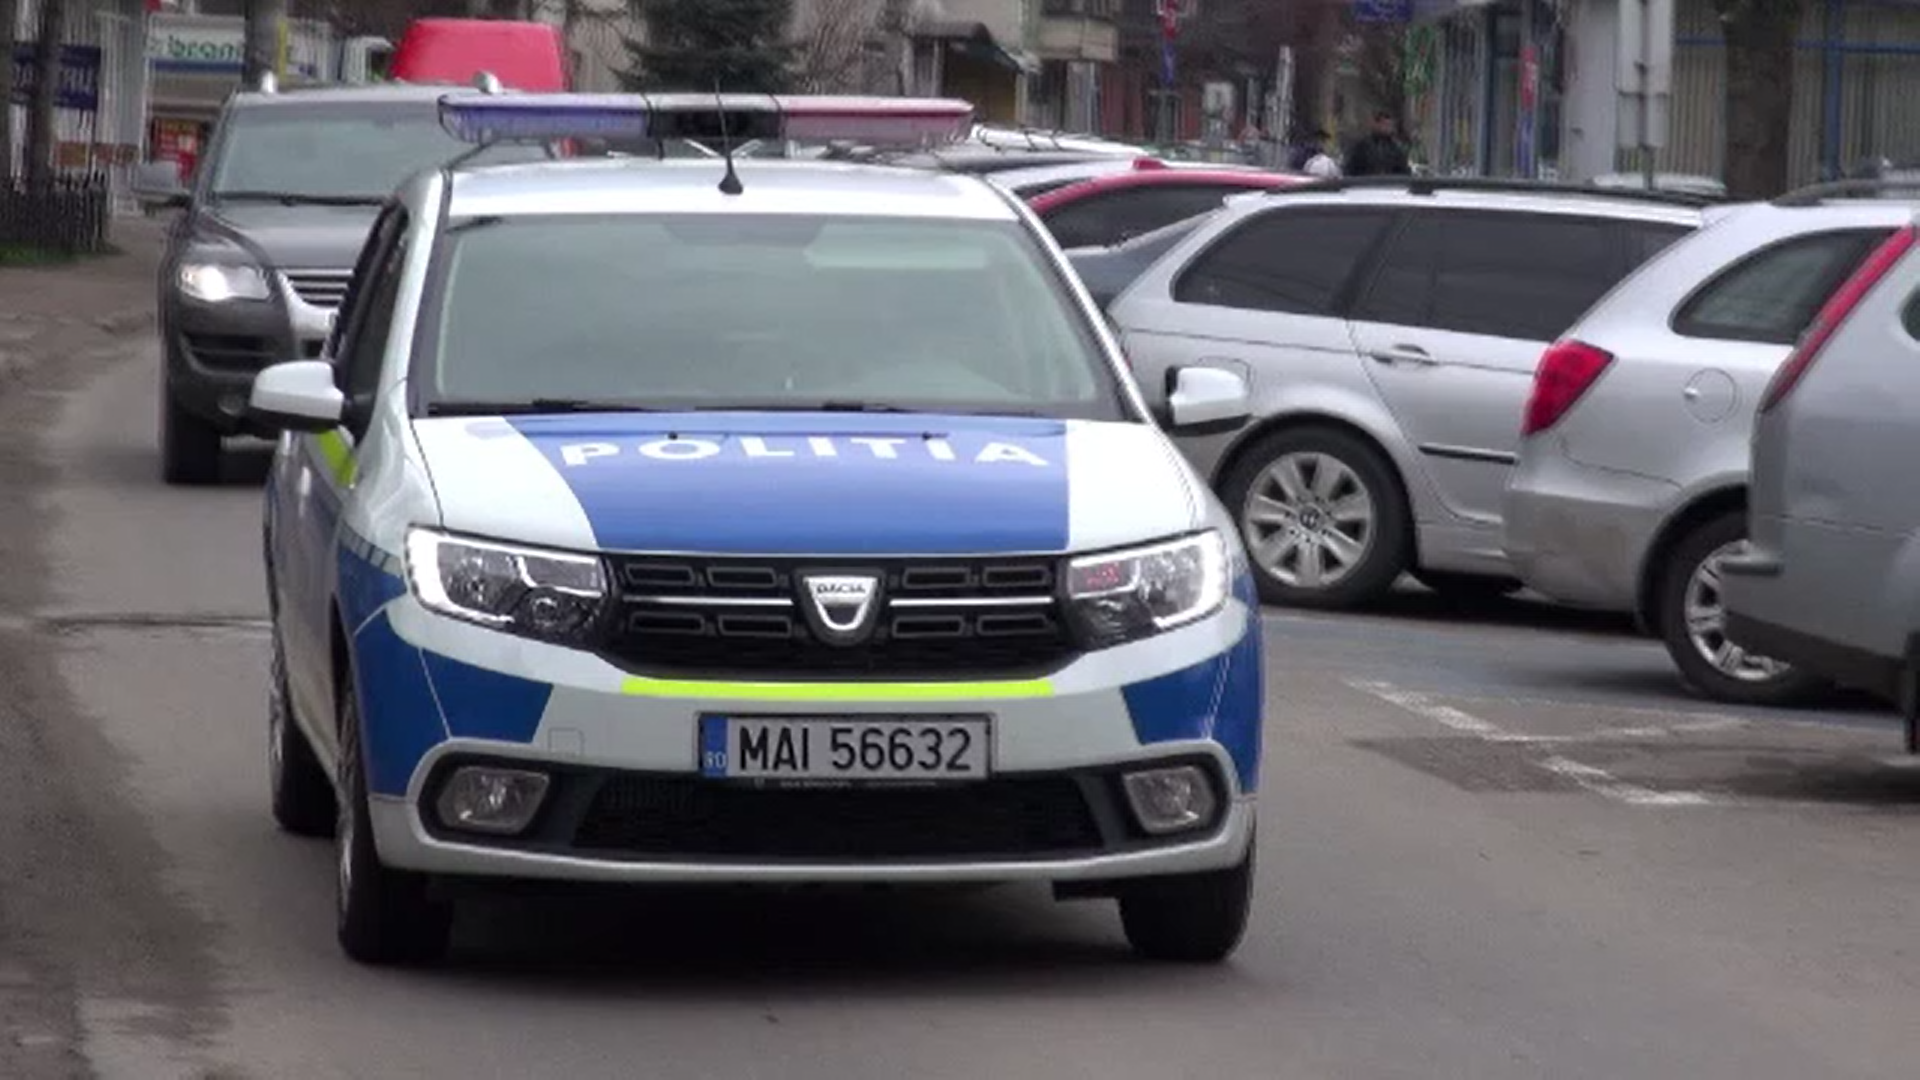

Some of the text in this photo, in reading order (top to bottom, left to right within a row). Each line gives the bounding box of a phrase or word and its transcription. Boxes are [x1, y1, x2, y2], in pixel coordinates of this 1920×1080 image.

[560, 437, 1050, 466] POLITIA
[816, 583, 866, 595] DACIA
[739, 726, 809, 771] MAI
[830, 727, 971, 771] 56632
